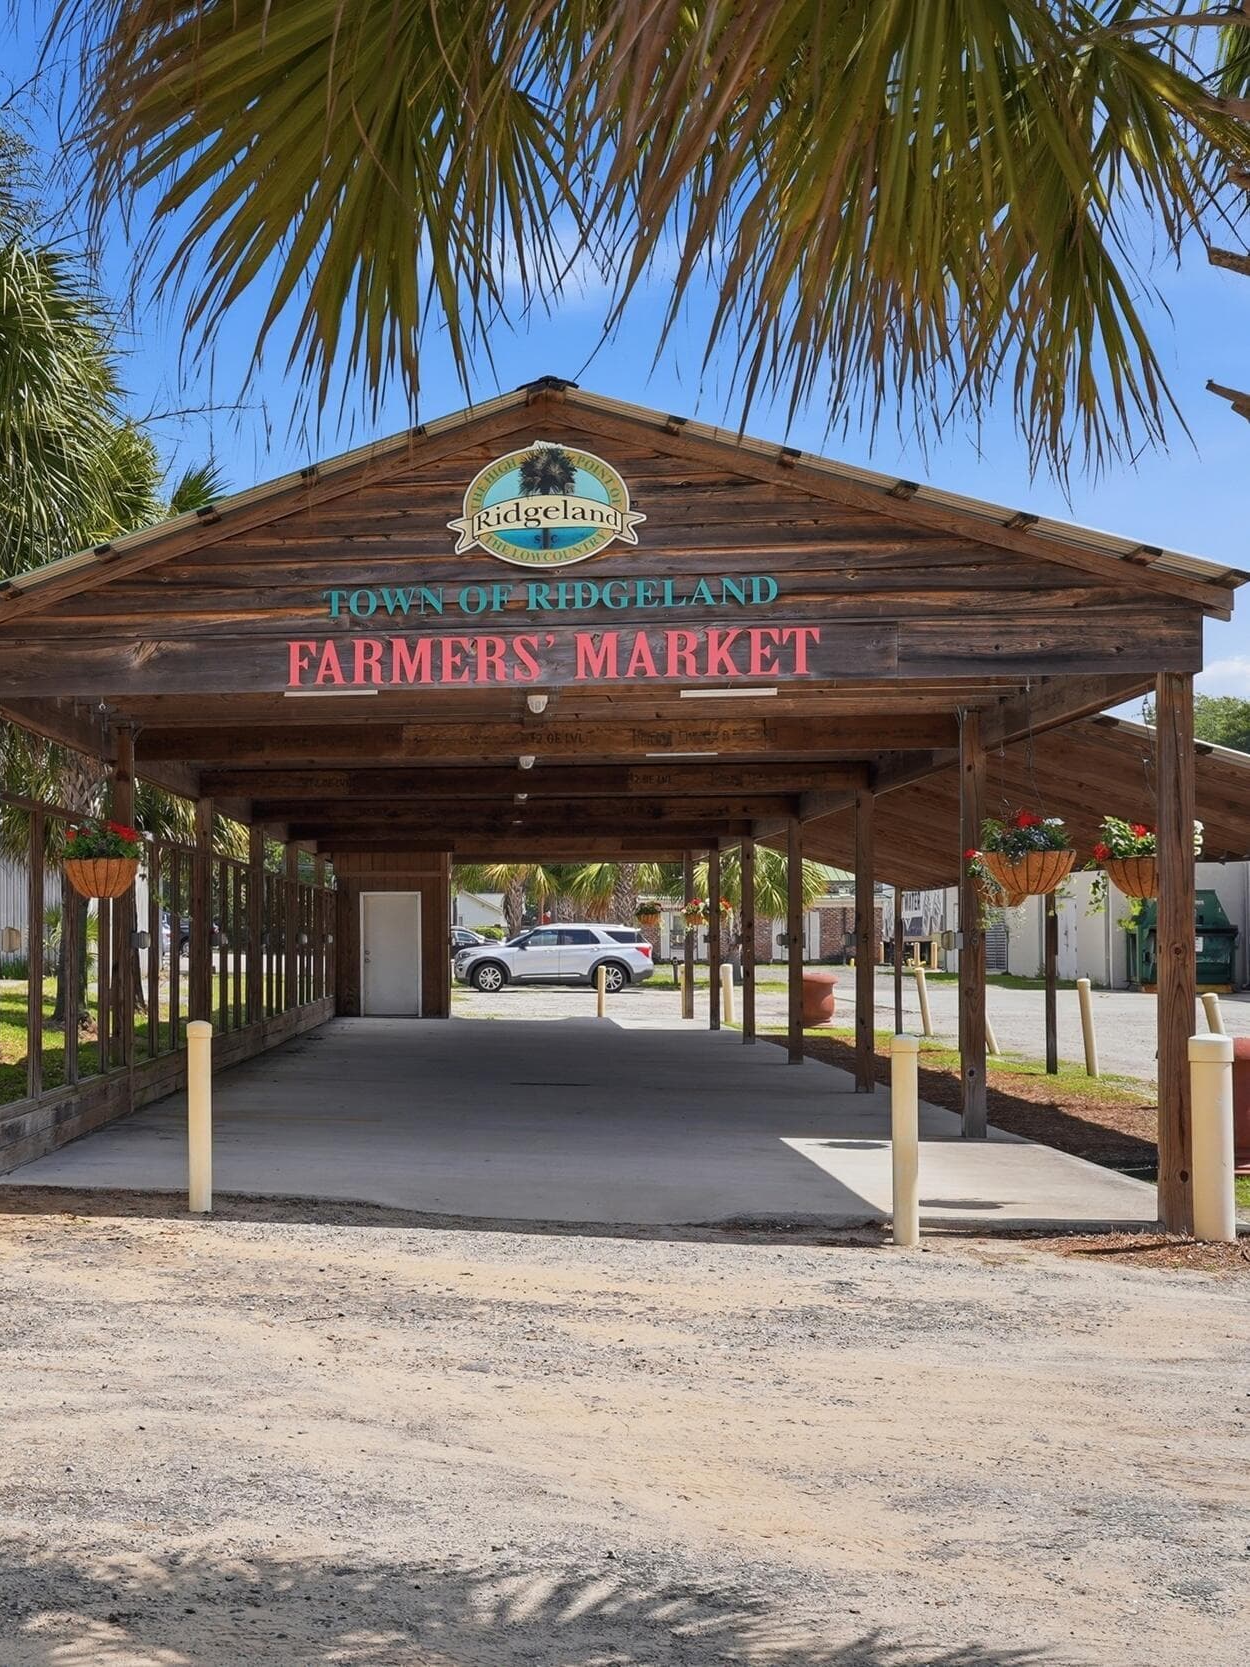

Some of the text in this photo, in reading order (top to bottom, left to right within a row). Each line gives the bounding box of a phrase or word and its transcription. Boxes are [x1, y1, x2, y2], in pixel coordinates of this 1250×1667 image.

[487, 458, 517, 483] HIGH
[576, 456, 615, 487] POINT
[476, 499, 619, 532] Ridgeland
[485, 535, 511, 556] THE
[322, 576, 778, 619] TOWN OF RIDGELAND
[286, 626, 820, 687] FARMERS' MARKET
